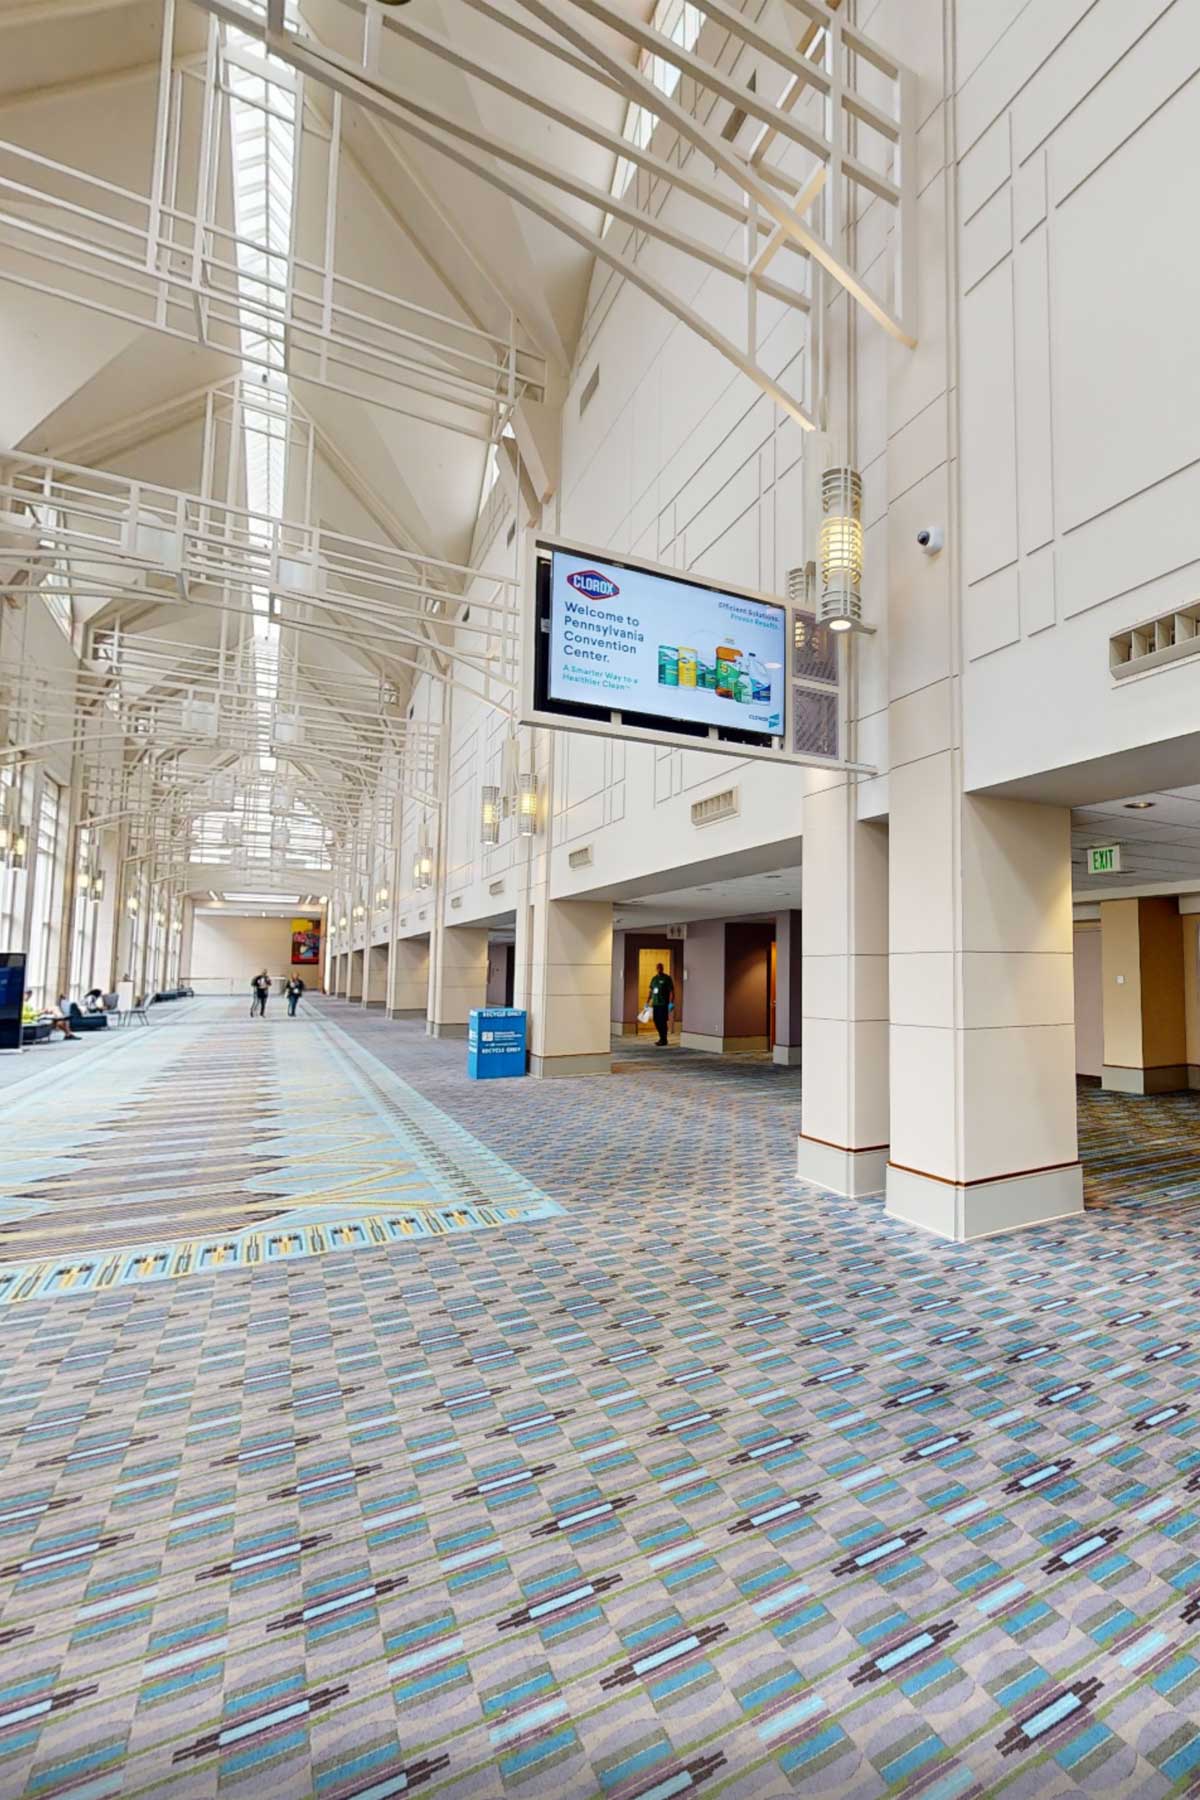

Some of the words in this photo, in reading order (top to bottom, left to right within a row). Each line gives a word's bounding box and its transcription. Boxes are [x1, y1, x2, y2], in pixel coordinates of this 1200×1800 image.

[573, 575, 614, 596] CLOROX
[564, 601, 624, 624] Welcome
[627, 616, 640, 627] to
[564, 616, 644, 642] Pennsylvania
[564, 630, 637, 654] Convention
[563, 644, 610, 663] Center.
[562, 674, 600, 686] Healthier
[571, 665, 602, 677] Smarter
[605, 671, 621, 681] Way
[1093, 849, 1114, 871] EXIT
